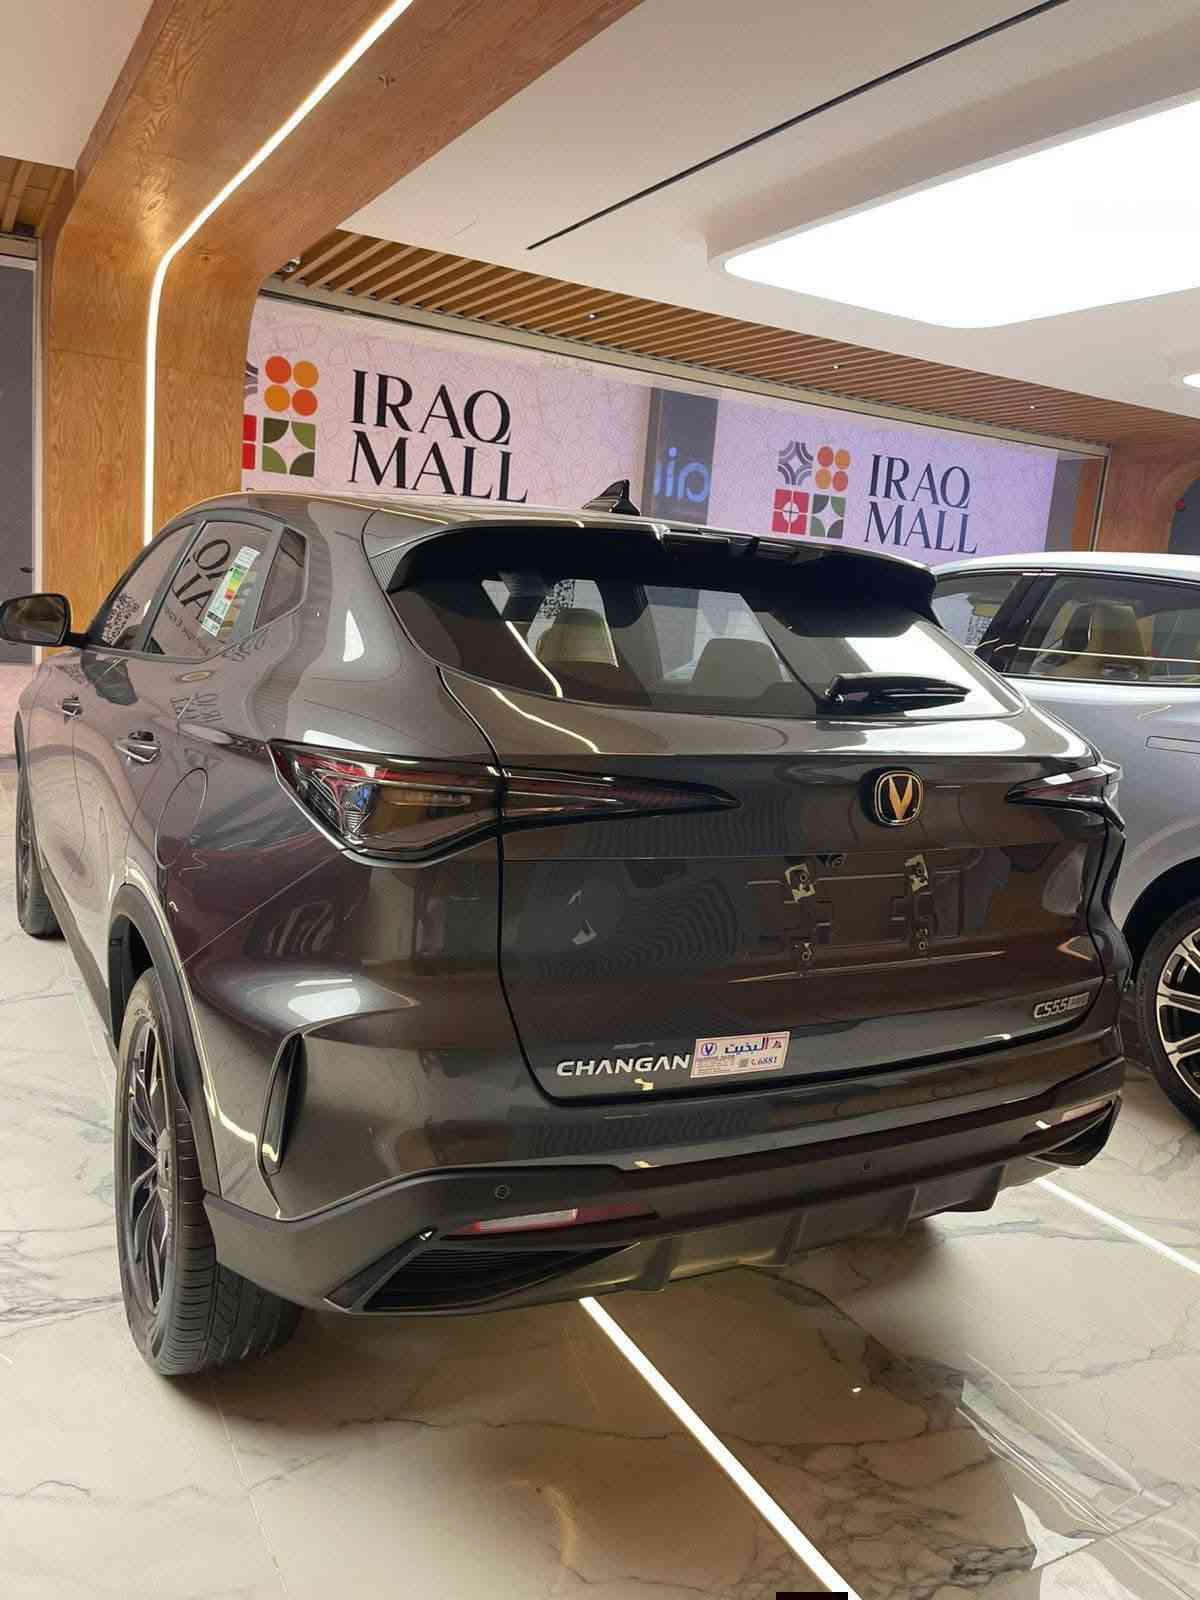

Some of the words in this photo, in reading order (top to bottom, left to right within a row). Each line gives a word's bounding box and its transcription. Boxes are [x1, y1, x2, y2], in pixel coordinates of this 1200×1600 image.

[350, 368, 512, 446] IRAQ
[348, 430, 529, 504] MALL
[868, 453, 971, 510] IRAQ
[864, 501, 978, 554] MALL
[556, 1054, 692, 1077] CHANGAN
